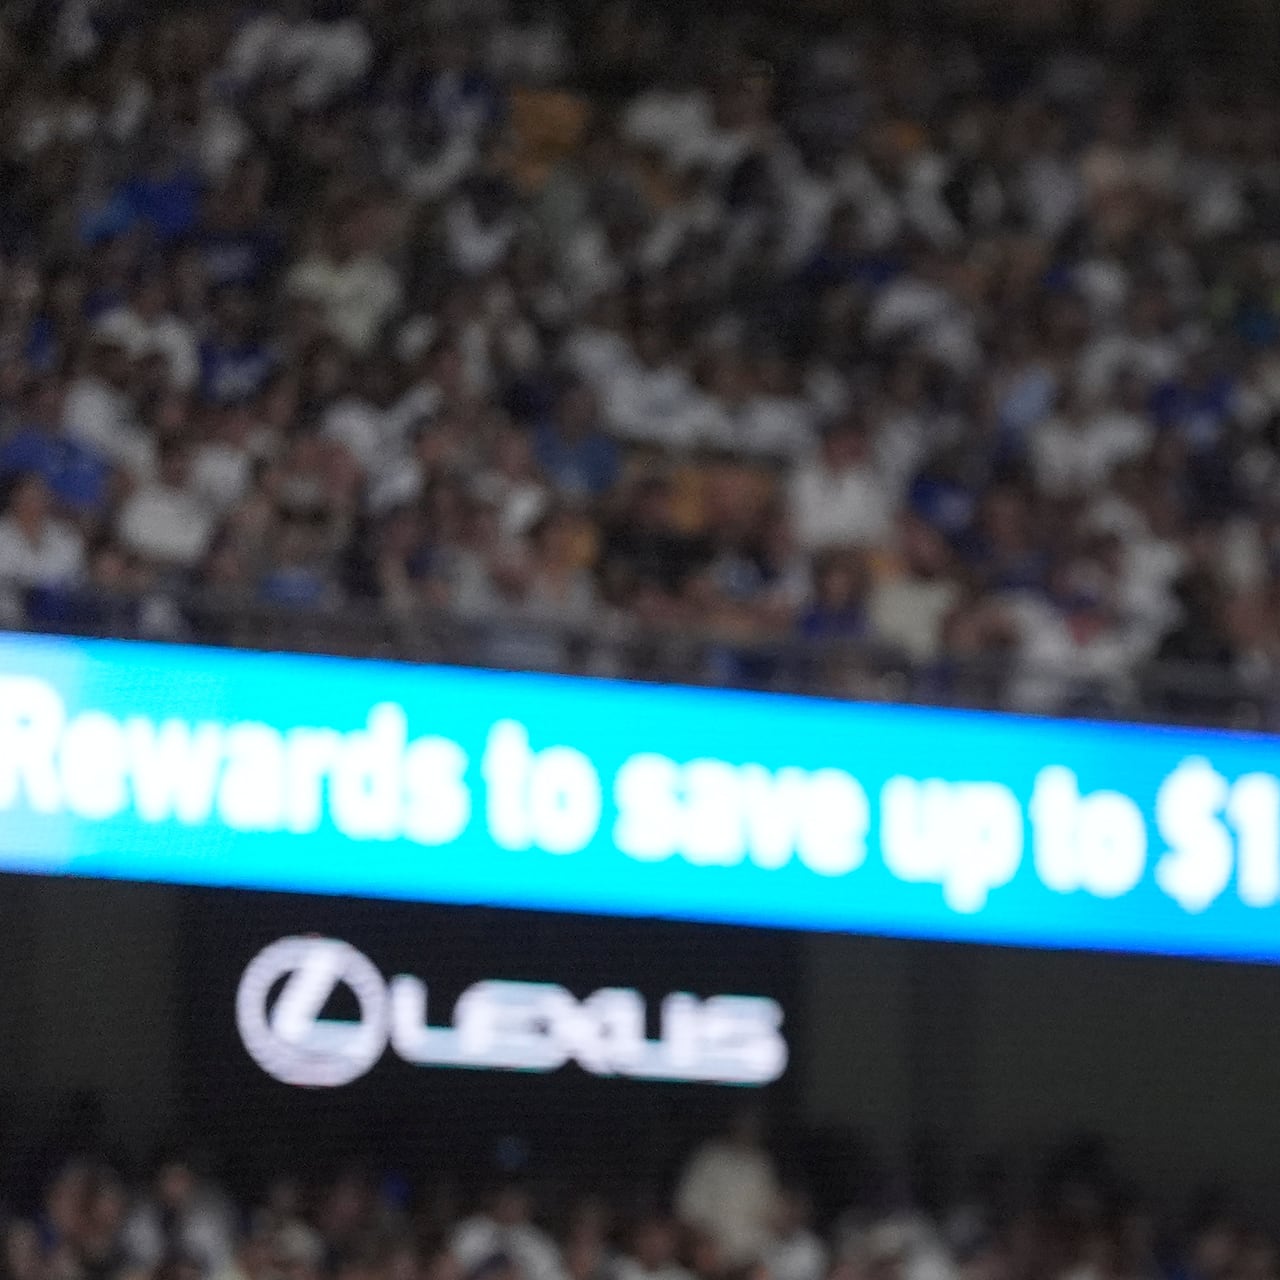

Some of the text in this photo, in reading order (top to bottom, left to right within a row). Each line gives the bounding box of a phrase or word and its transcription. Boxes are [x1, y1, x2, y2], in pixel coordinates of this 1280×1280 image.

[0, 677, 470, 846] Rewards
[483, 718, 601, 854] to
[613, 751, 868, 877] save
[880, 775, 1024, 914] up
[1031, 764, 1147, 898] to
[390, 973, 789, 1088] LEXUS
